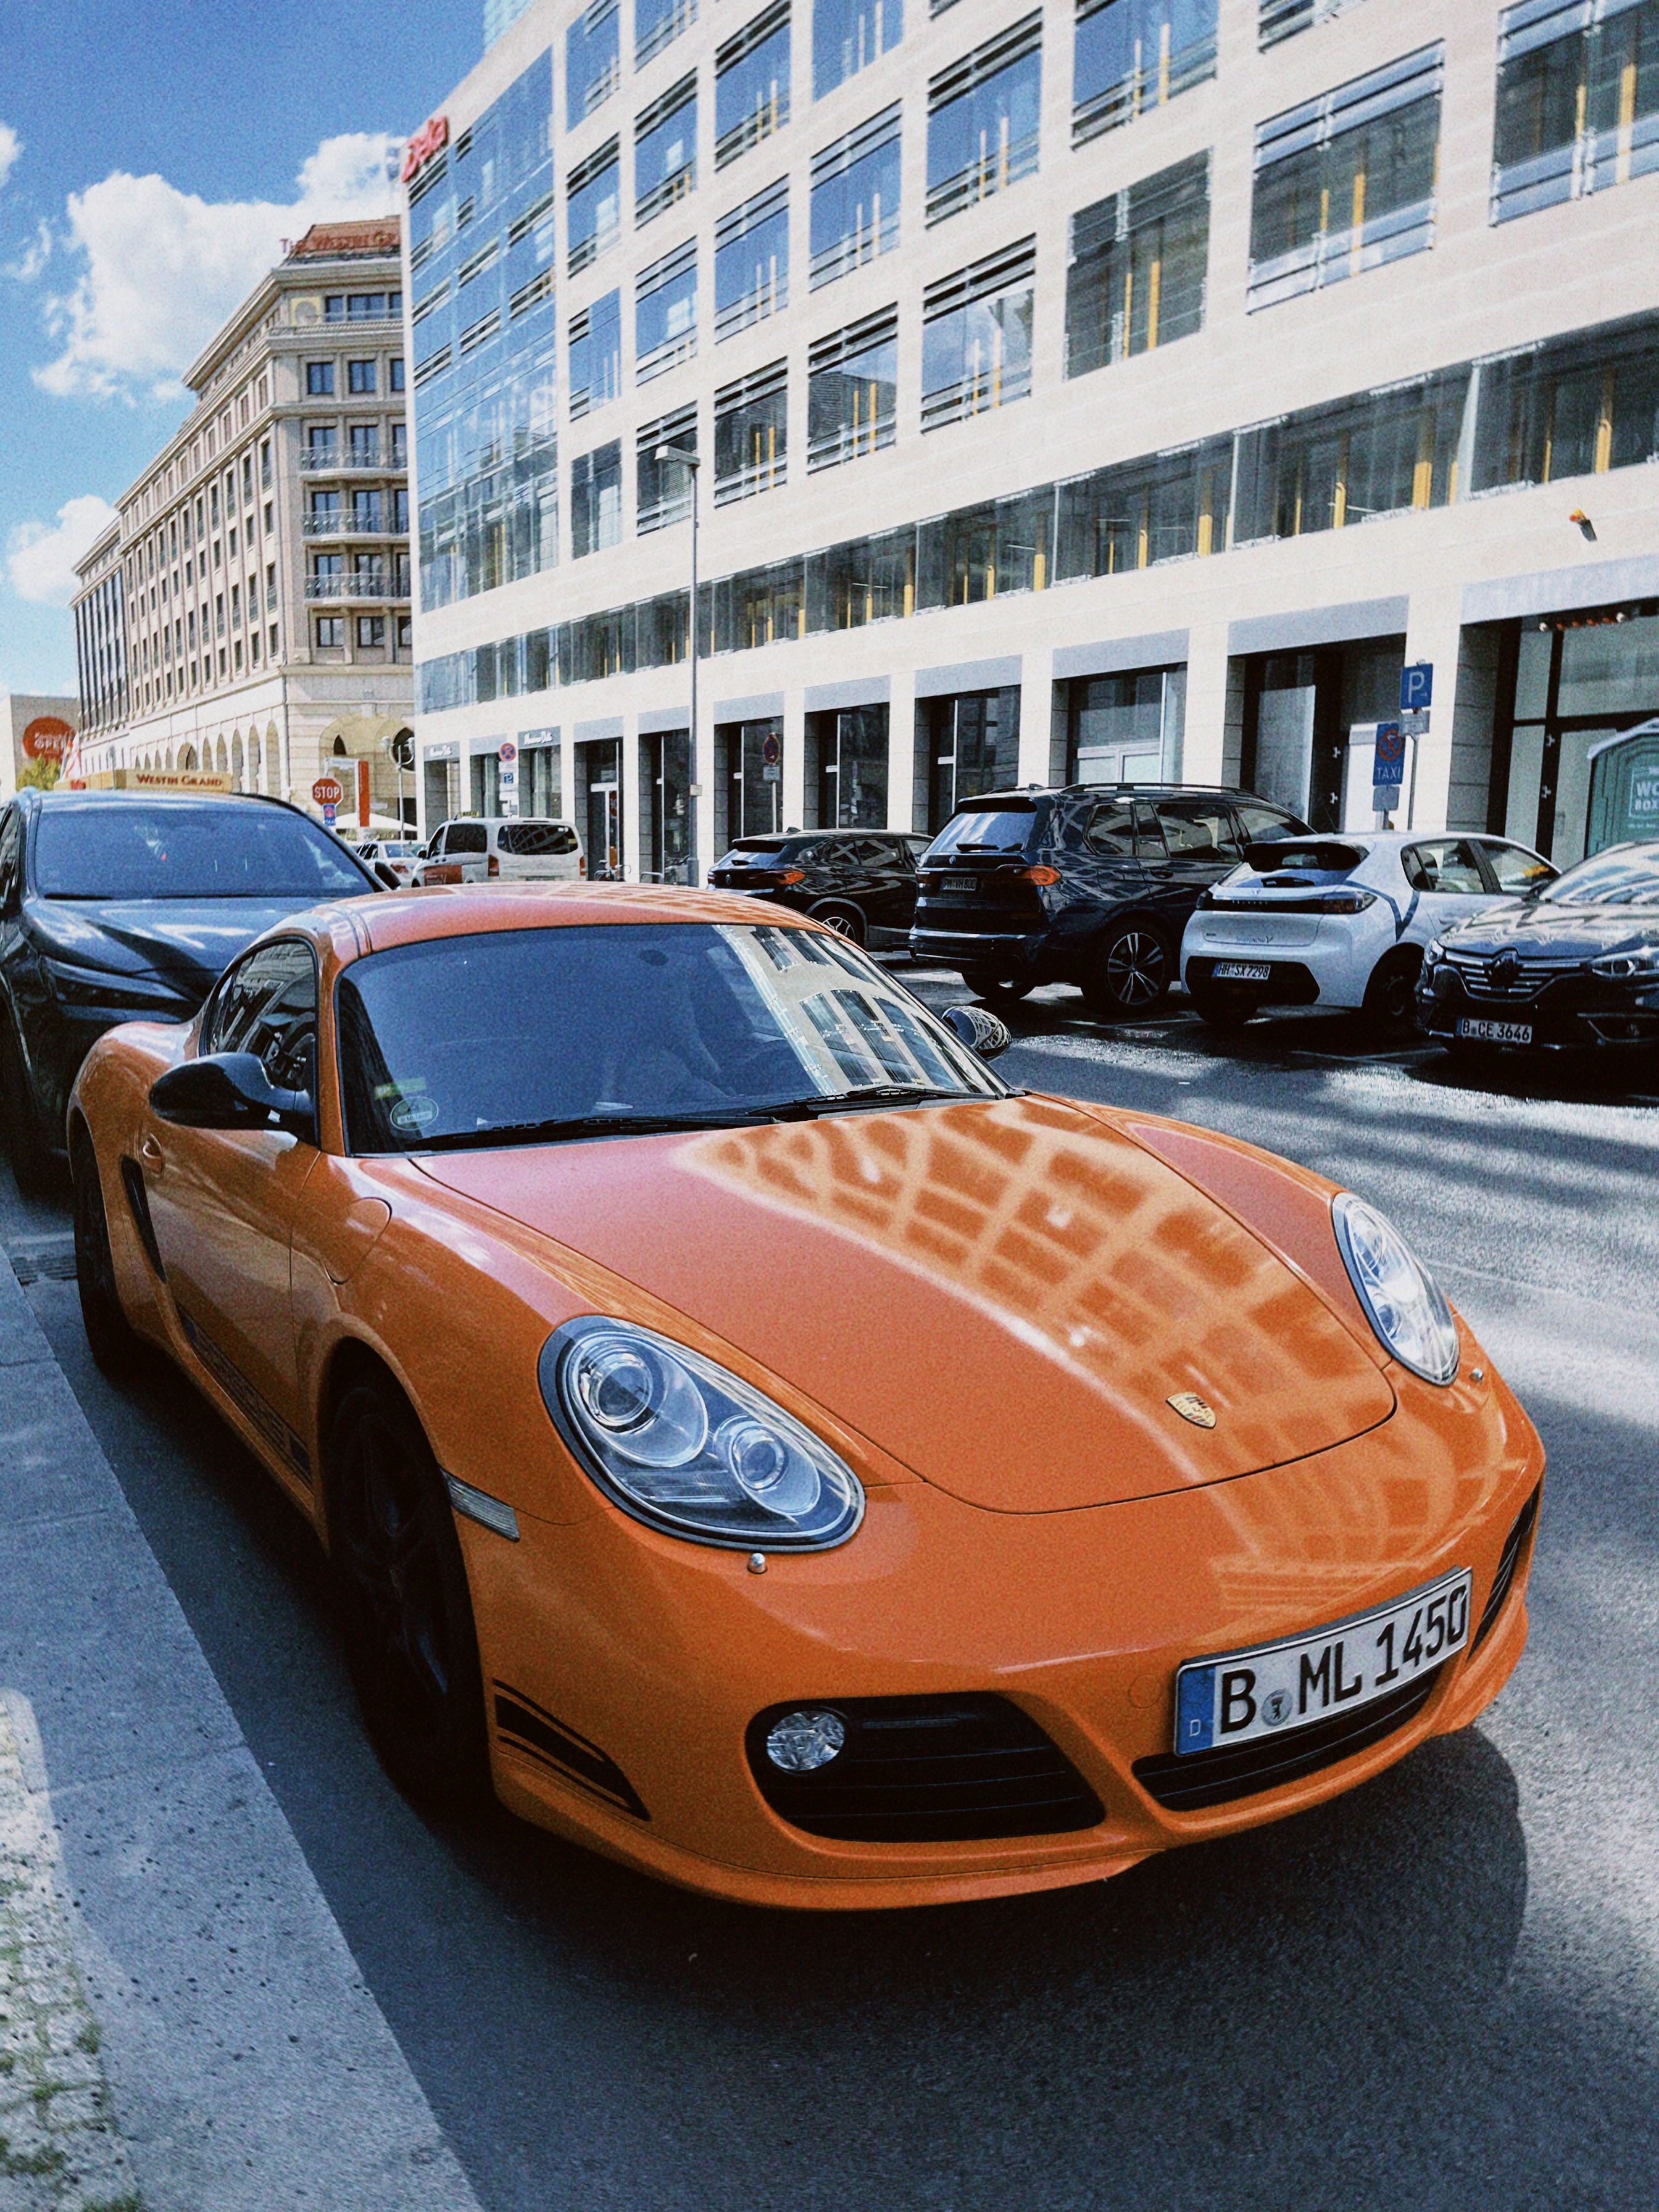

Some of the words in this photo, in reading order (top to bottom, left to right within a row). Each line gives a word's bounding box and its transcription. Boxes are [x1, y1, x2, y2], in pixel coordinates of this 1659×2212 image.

[1408, 672, 1424, 703] P
[1376, 766, 1401, 780] TAXI
[314, 786, 339, 799] STOP
[1218, 963, 1230, 975] HH
[1235, 964, 1247, 976] SX
[1247, 965, 1270, 978] 7298
[1462, 1020, 1470, 1034] B
[1478, 1021, 1494, 1037] CE
[1497, 1023, 1530, 1041] 3646
[1220, 1667, 1257, 1734] B
[1298, 1640, 1362, 1715] ML
[1374, 1584, 1467, 1687] 1450
[1189, 1719, 1201, 1737] D
